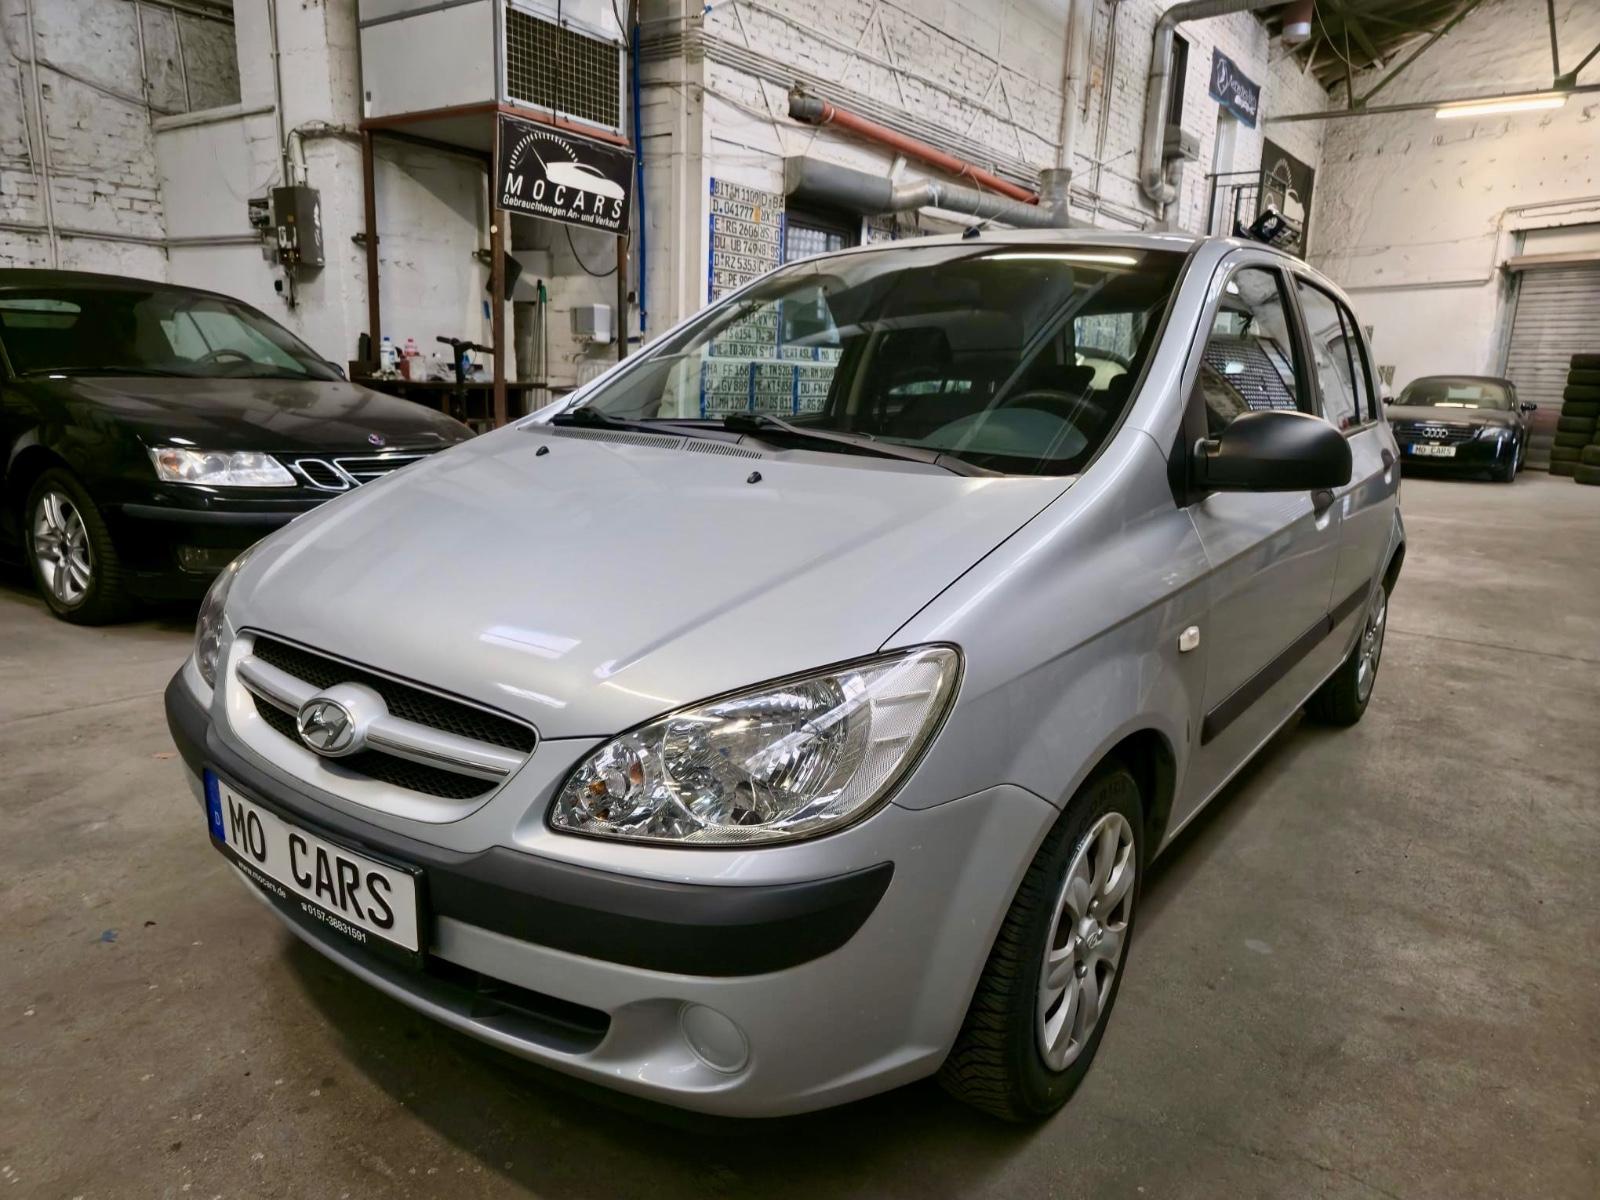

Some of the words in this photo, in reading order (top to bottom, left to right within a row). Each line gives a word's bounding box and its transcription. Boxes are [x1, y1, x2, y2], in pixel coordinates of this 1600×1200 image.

[503, 194, 566, 216] Gebrauchtwagen
[581, 214, 594, 222] und
[596, 214, 620, 228] Verkauf
[715, 218, 720, 230] E
[726, 220, 737, 234] RG
[739, 223, 759, 237] 2606
[743, 241, 757, 256] 749
[715, 254, 719, 266] D
[725, 257, 735, 269] RZ
[737, 259, 756, 272] 5353
[1415, 446, 1426, 454] MO
[1431, 446, 1452, 455] CARS
[228, 794, 266, 863] MO
[288, 832, 394, 930] CARS
